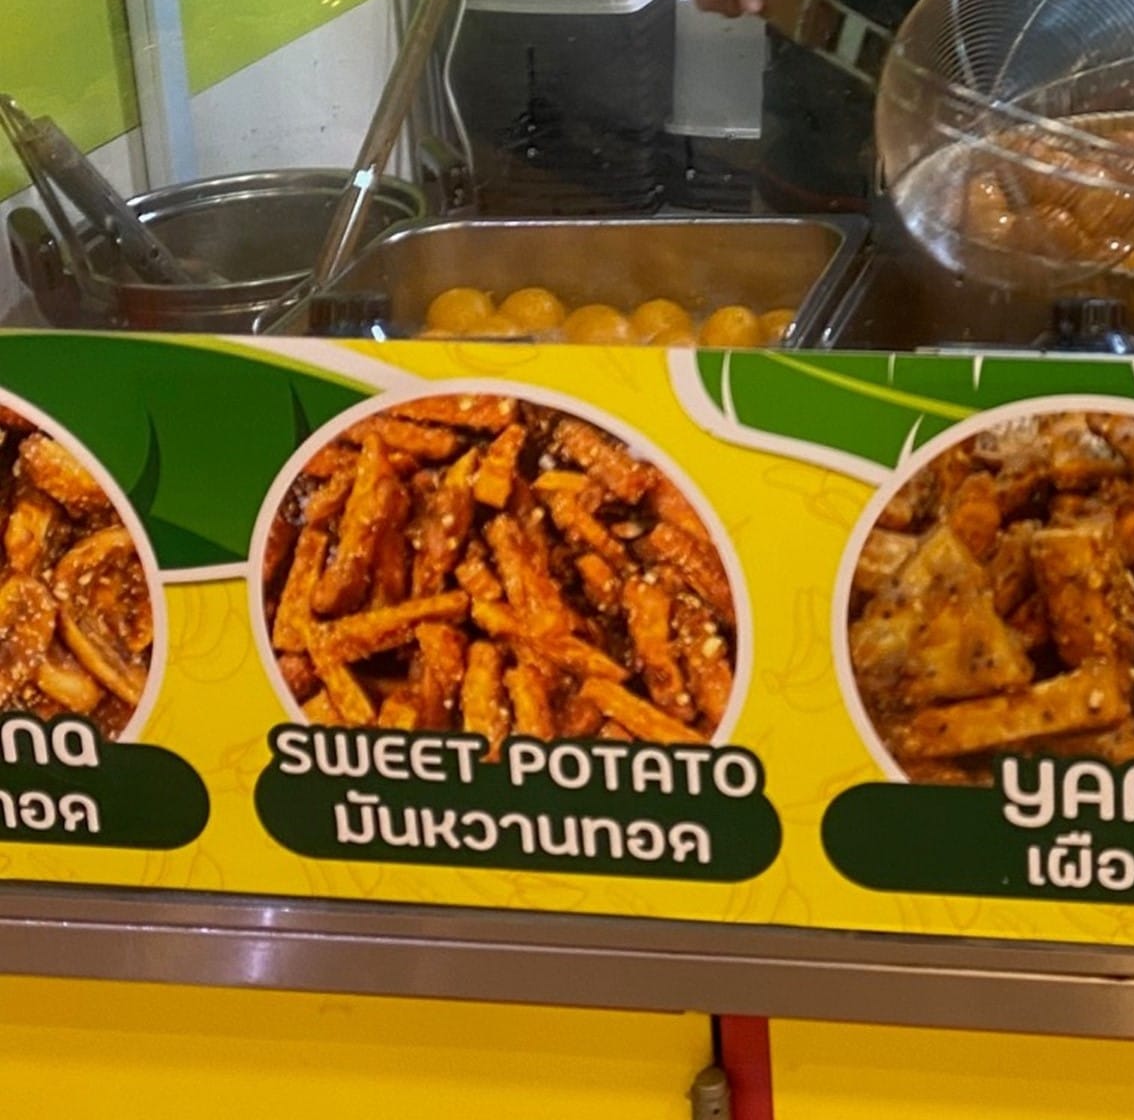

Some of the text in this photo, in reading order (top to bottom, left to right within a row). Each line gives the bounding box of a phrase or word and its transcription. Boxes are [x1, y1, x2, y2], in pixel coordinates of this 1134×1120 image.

[276, 730, 758, 798] SWEET POTATO
[333, 789, 712, 864] มันหวานทอด
